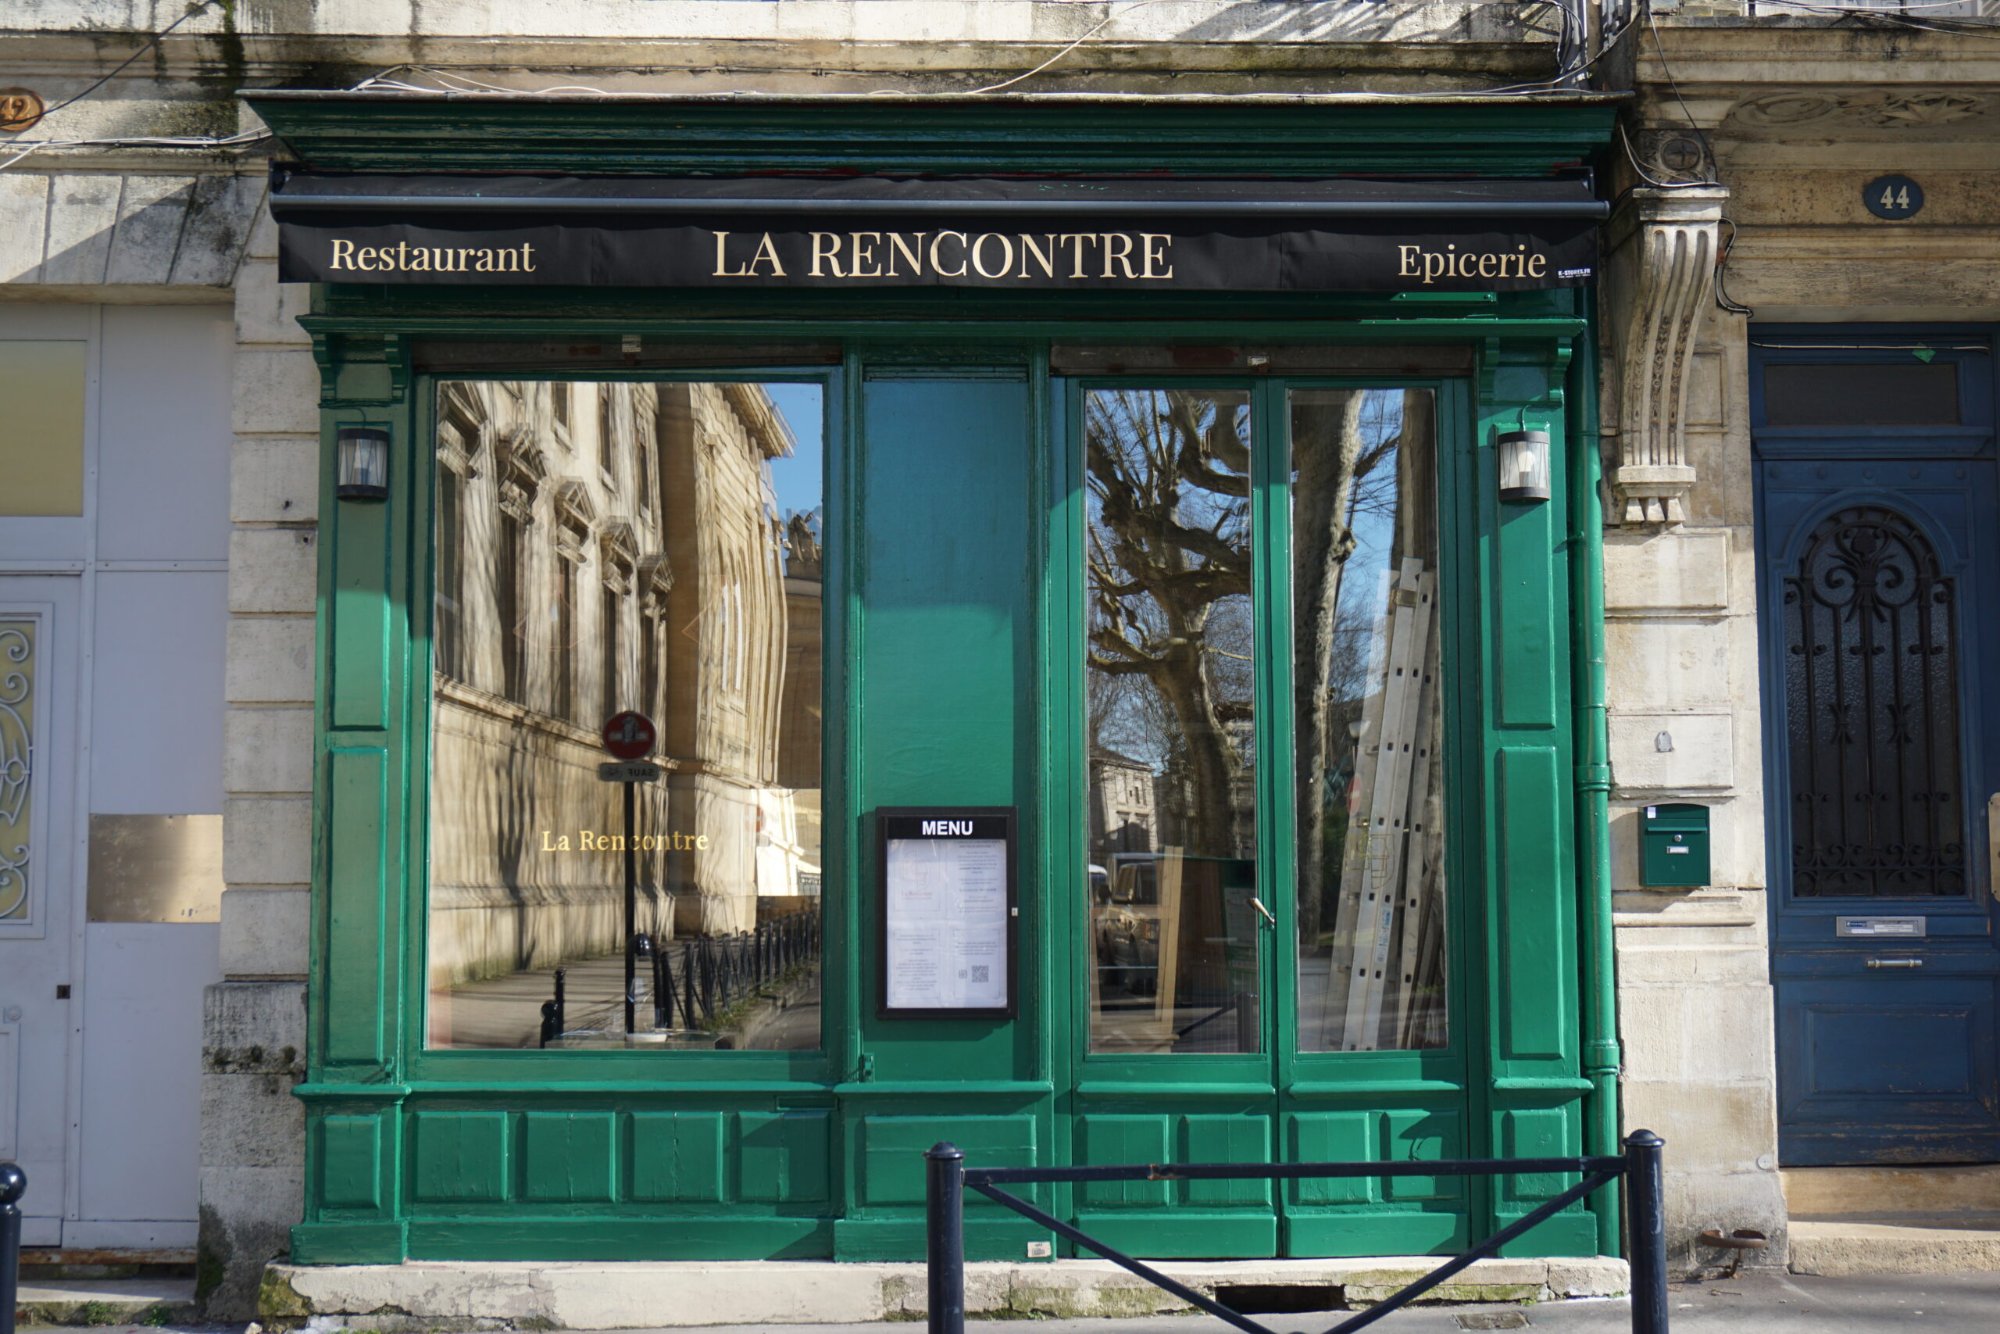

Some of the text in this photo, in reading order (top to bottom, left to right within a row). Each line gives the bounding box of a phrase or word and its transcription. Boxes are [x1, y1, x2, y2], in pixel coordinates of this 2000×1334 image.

[1880, 185, 1910, 209] 44
[329, 238, 537, 273] Restaurant
[711, 230, 1174, 279] LA RENCONTRE
[1397, 243, 1547, 284] Epicerie
[541, 830, 709, 852] La Rencontre
[922, 820, 974, 836] MENU
